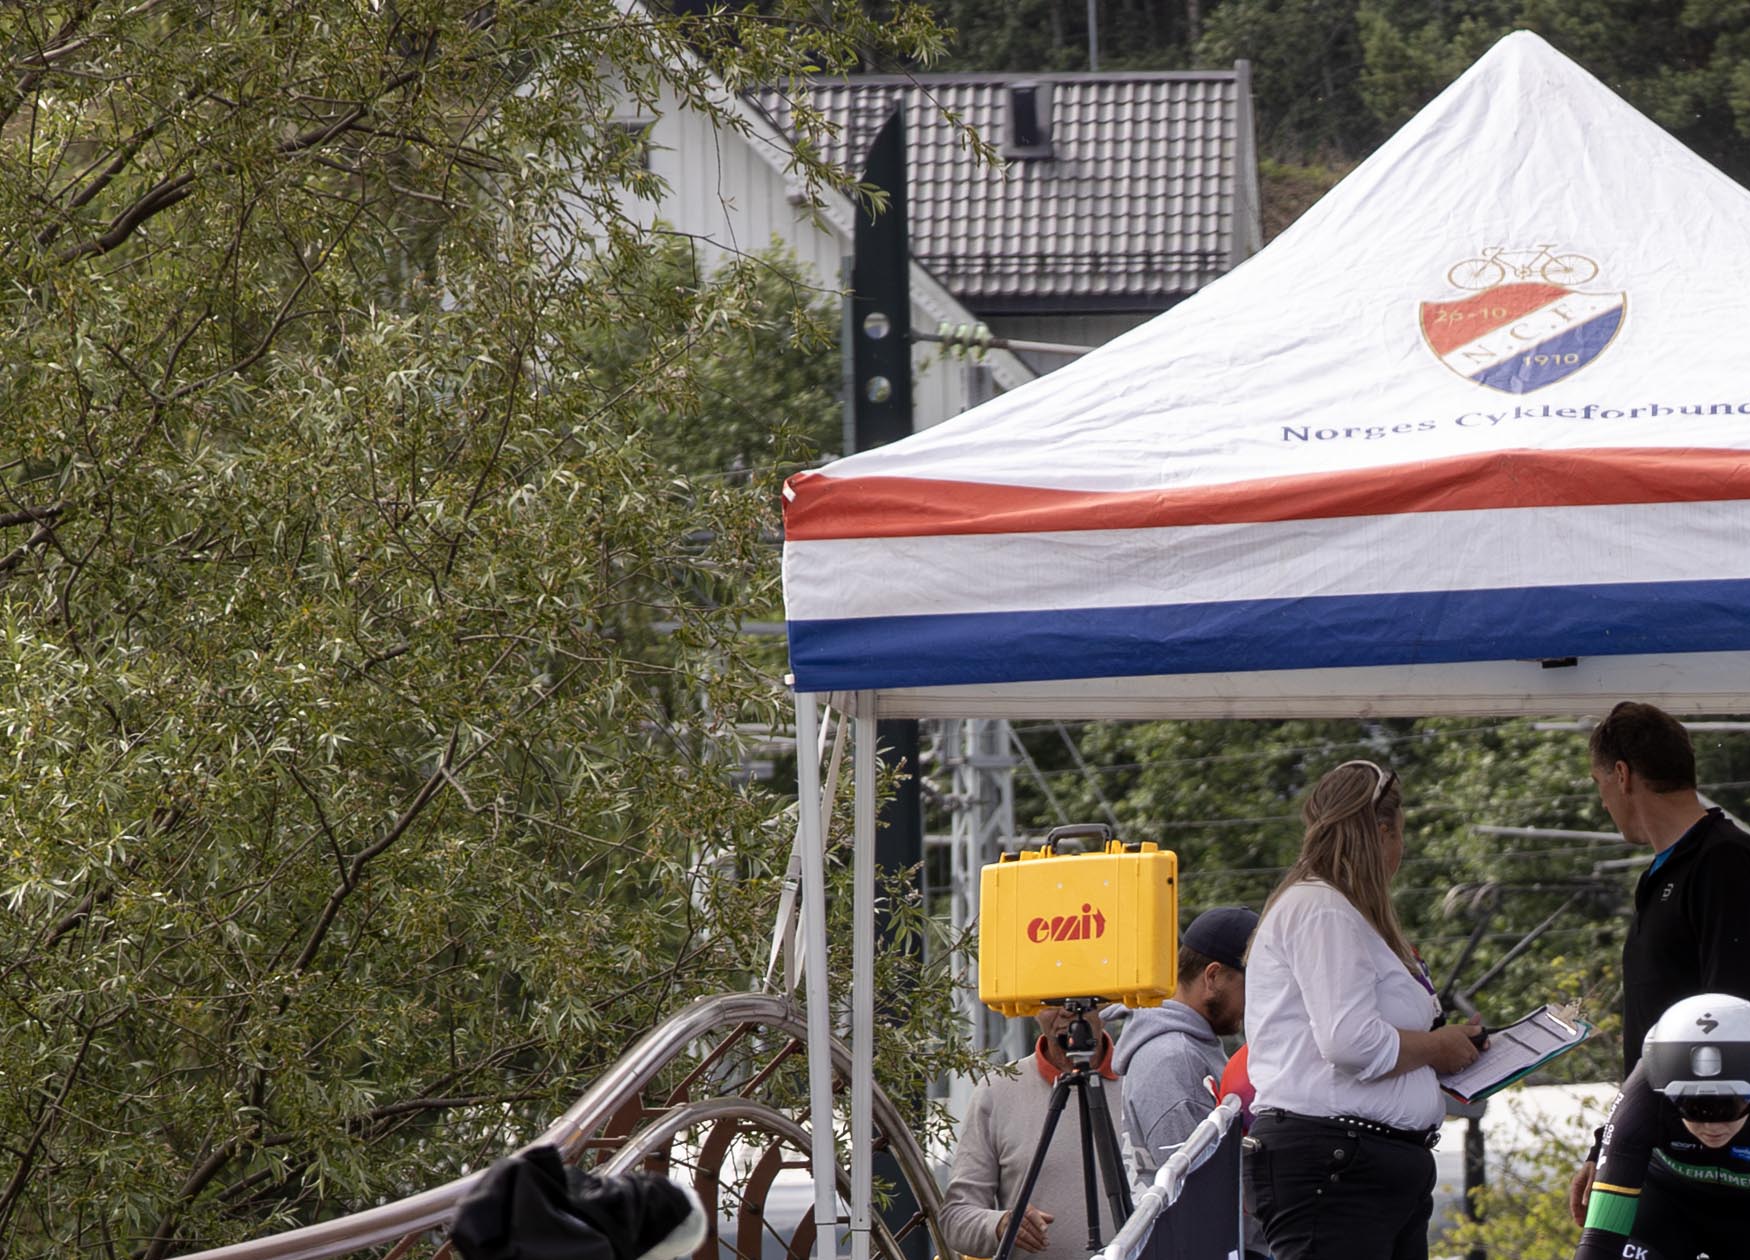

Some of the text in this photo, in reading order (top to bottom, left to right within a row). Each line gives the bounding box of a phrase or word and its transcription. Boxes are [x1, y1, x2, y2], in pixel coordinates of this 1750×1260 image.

[1523, 353, 1580, 367] 1910
[1281, 417, 1436, 442] Norges
[1027, 902, 1106, 944] emit
